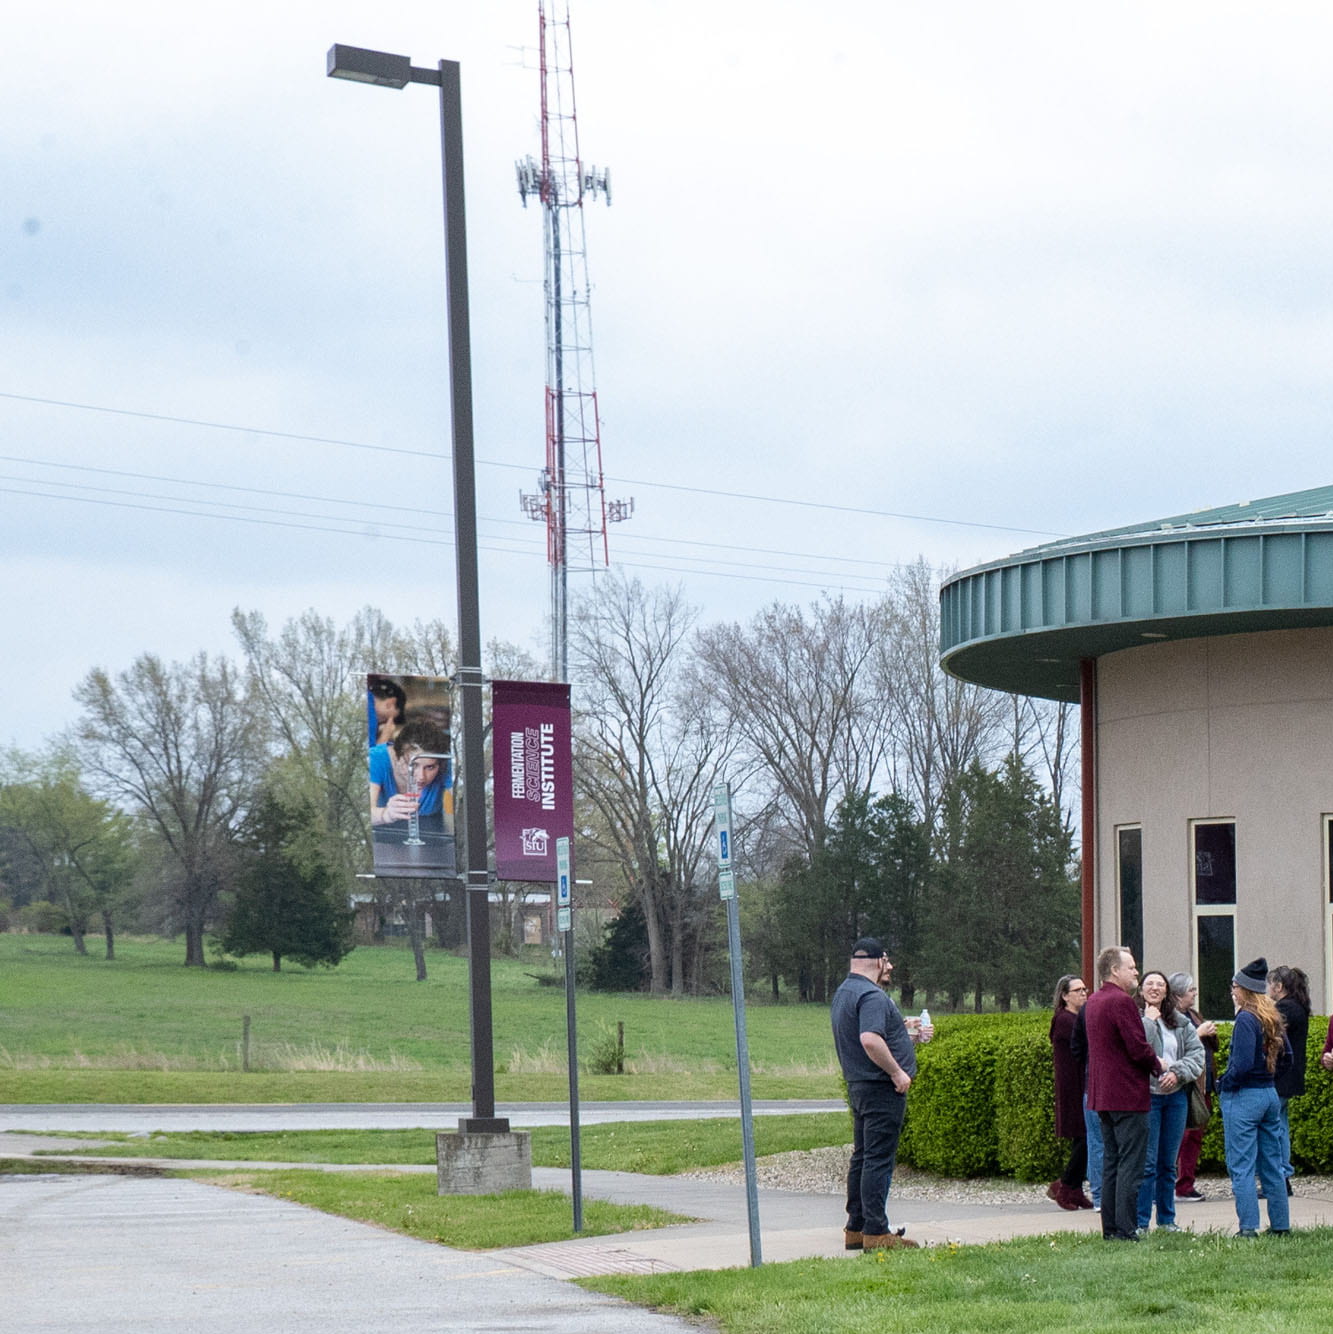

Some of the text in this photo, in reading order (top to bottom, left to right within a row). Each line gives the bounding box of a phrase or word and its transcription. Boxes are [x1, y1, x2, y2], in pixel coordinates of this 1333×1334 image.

[511, 731, 525, 799] FERMENTATION
[525, 727, 541, 803] SCIENCE
[540, 723, 556, 811] INSTITUTE
[526, 840, 545, 851] SIU
